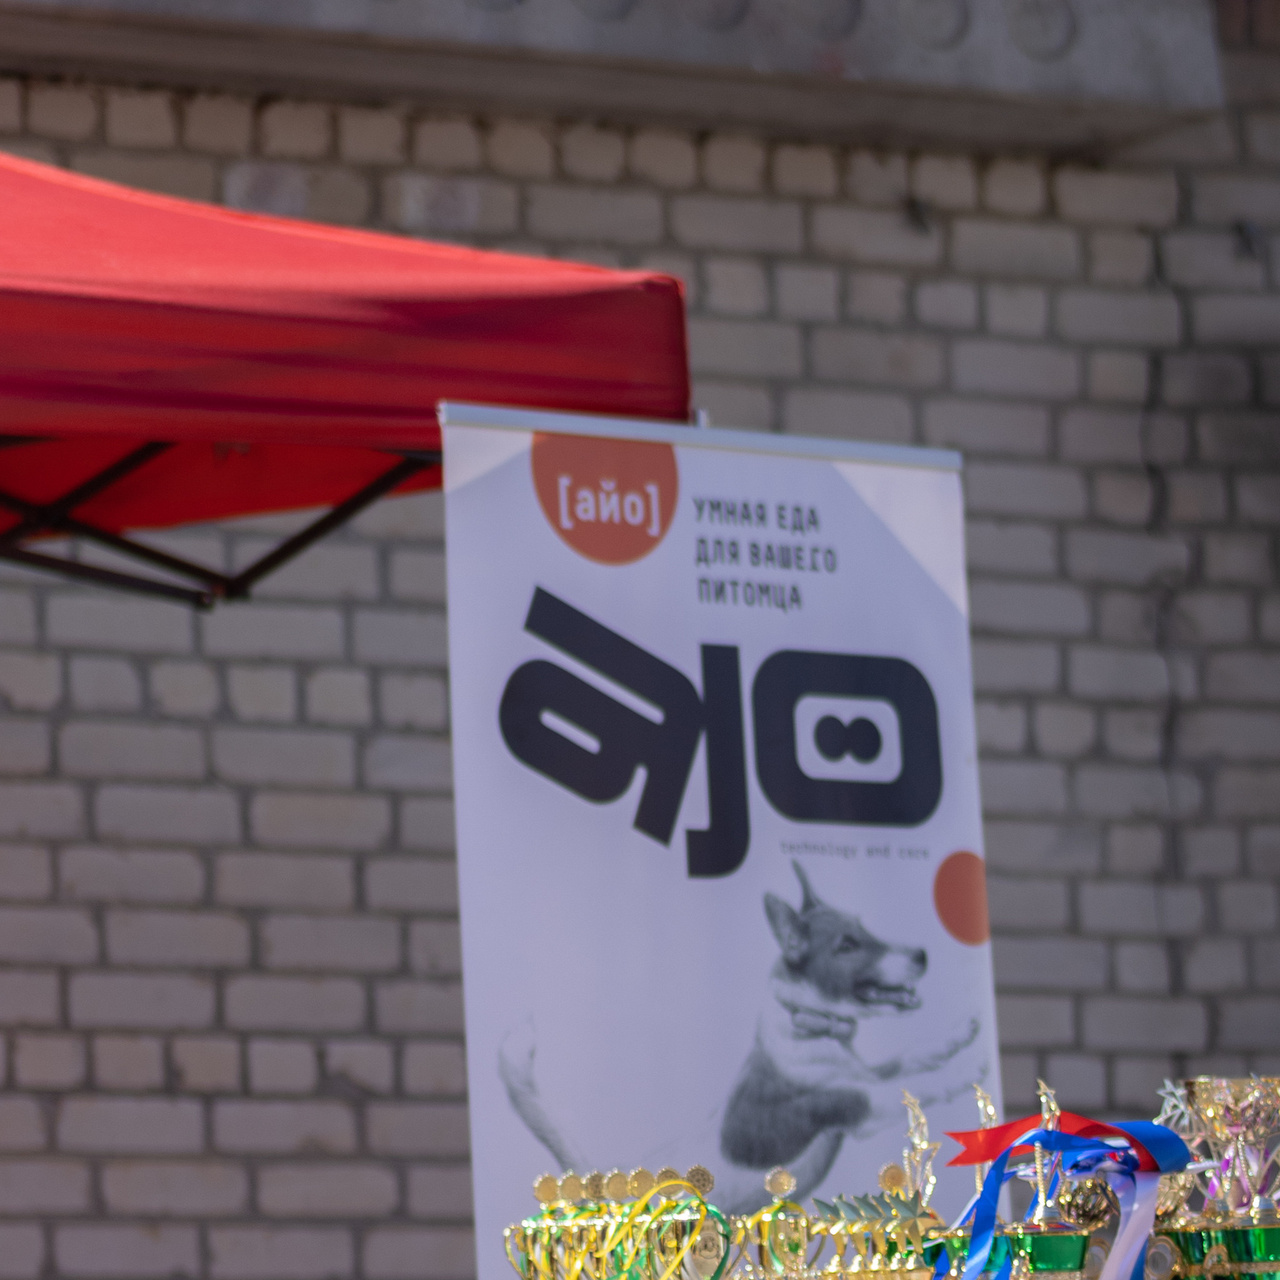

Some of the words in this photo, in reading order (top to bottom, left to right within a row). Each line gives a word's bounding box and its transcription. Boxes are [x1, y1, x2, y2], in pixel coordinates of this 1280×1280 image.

[692, 496, 767, 528] УМНАЯ
[776, 504, 821, 535] ЕДА
[696, 537, 740, 568] ДЛЯ
[749, 541, 838, 573] ВАШЕГО
[698, 577, 802, 613] ПИТОМЦА
